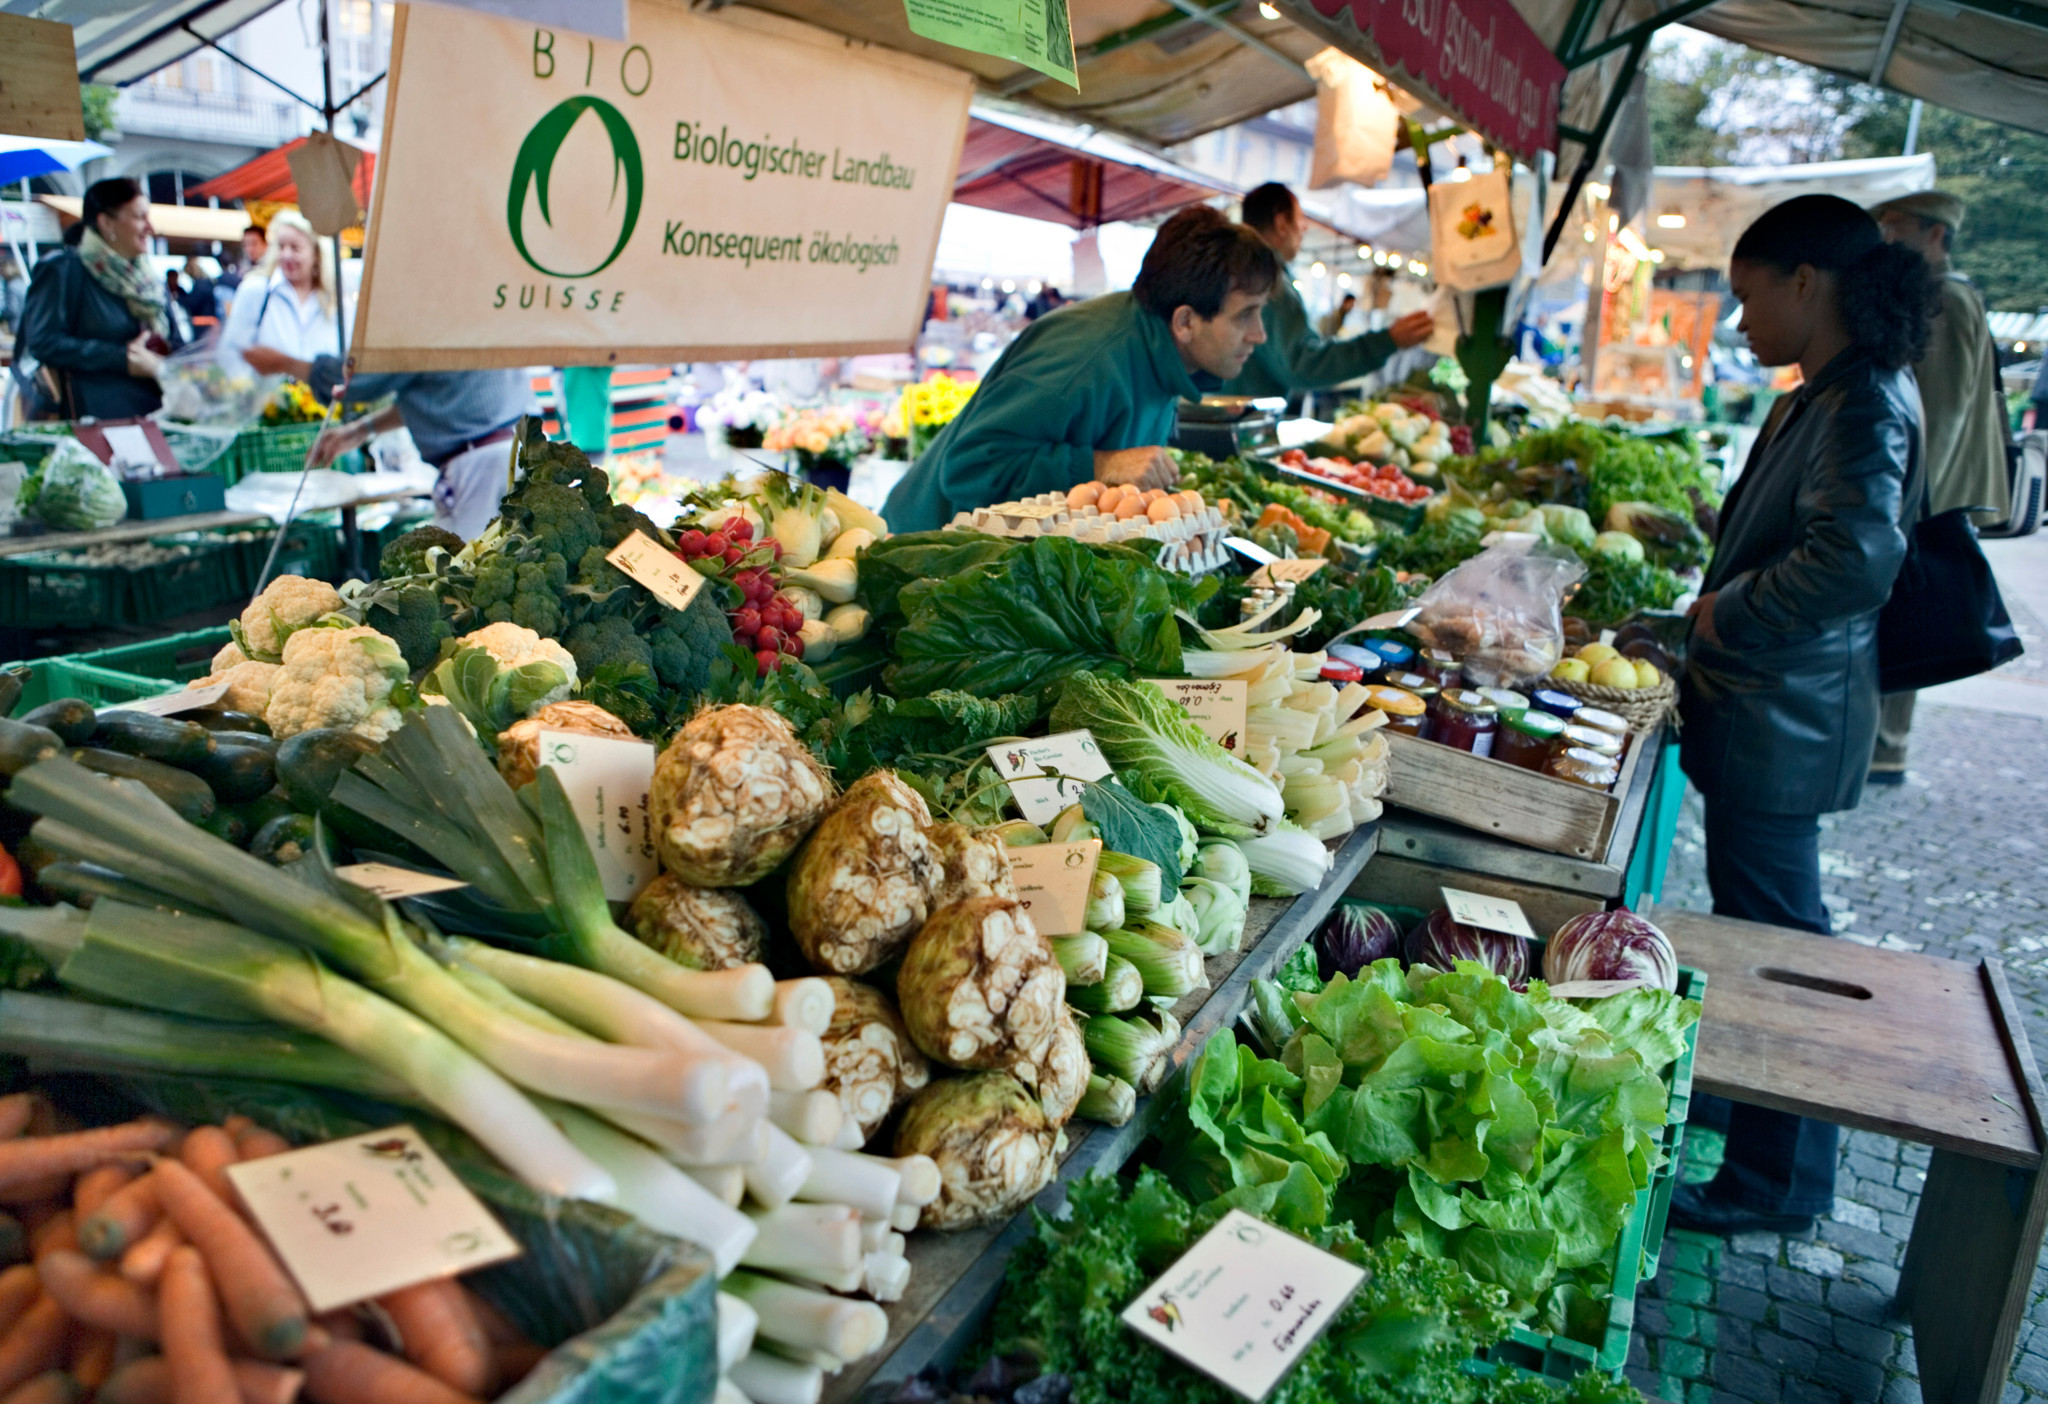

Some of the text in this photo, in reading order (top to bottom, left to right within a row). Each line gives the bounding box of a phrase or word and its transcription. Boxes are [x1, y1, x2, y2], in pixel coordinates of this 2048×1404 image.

[533, 29, 653, 96] BIO
[673, 121, 915, 190] Biologischer Landbau
[662, 221, 900, 274] Konsequent ökologisch
[493, 284, 626, 313] SUISSE
[1179, 695, 1202, 706] 0.60
